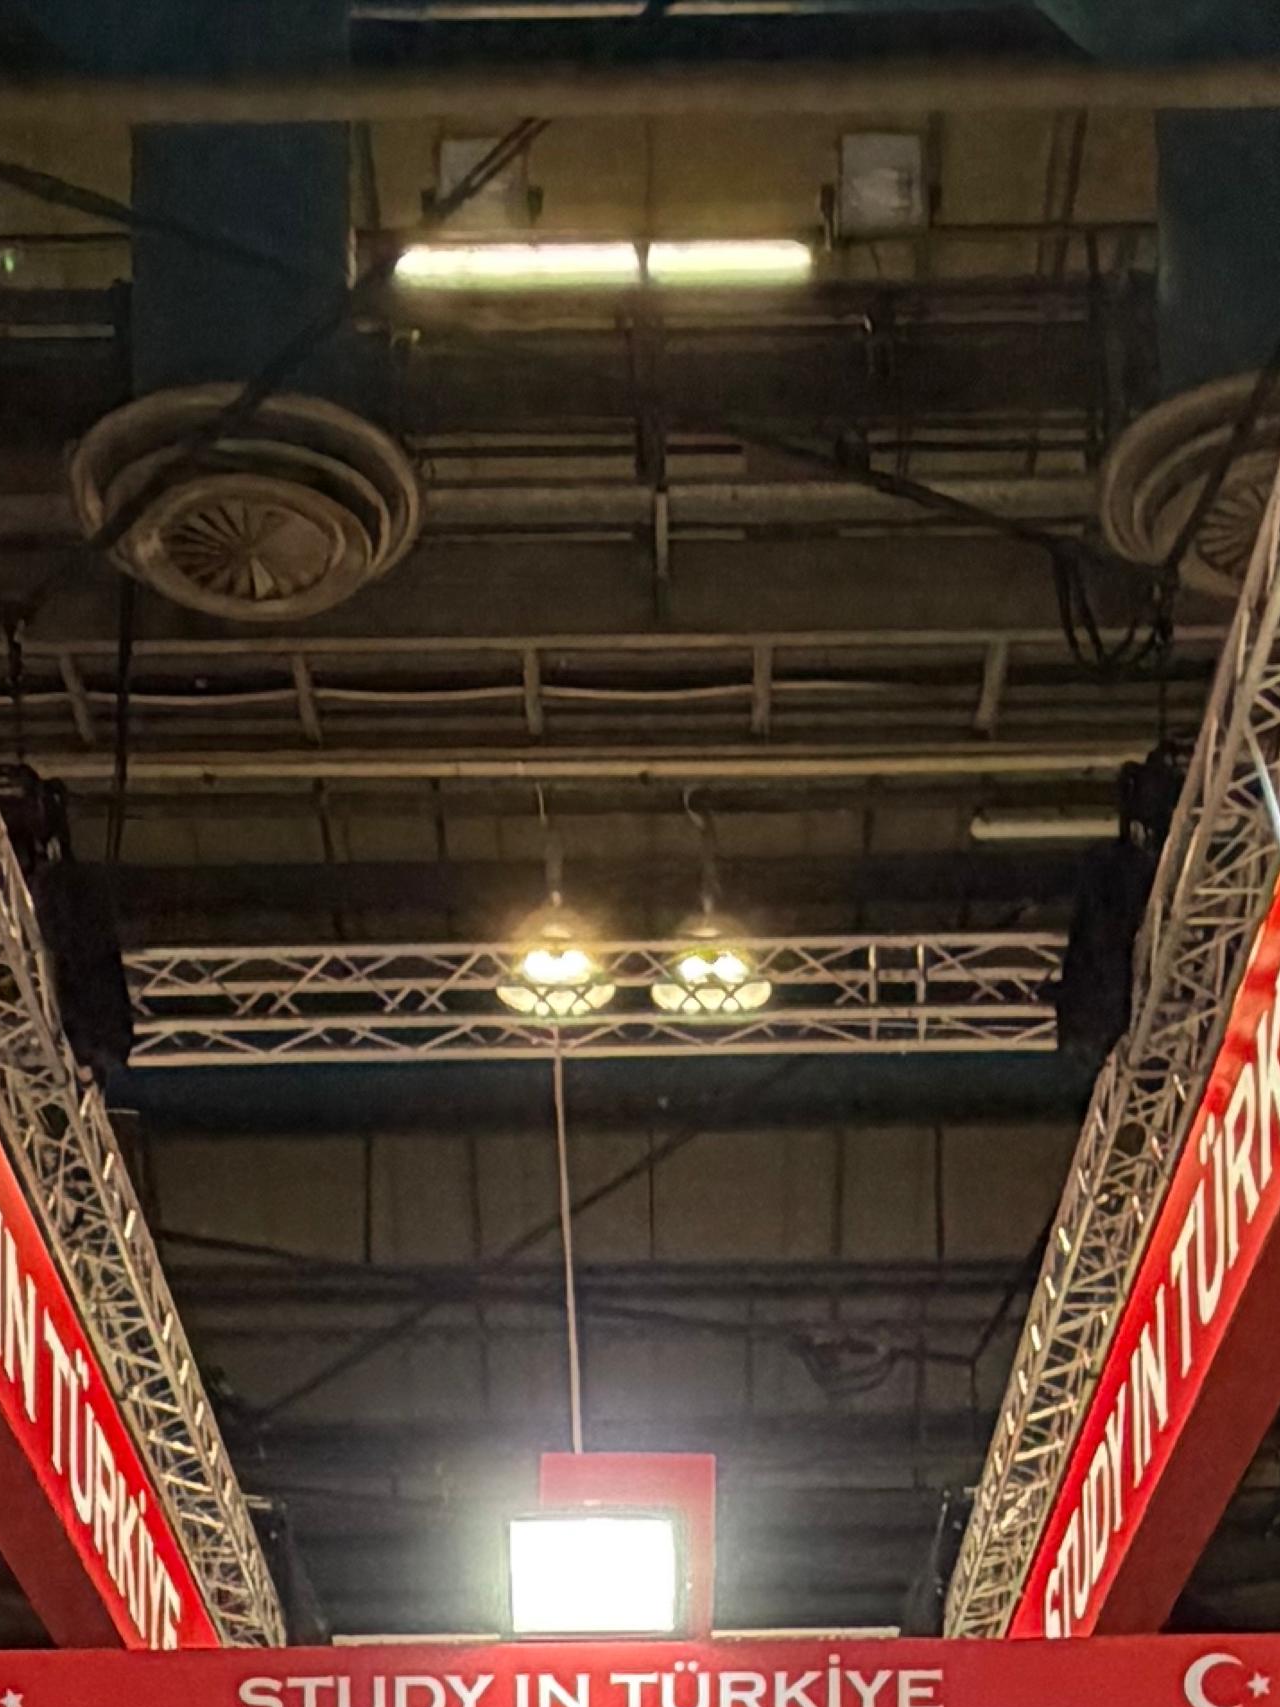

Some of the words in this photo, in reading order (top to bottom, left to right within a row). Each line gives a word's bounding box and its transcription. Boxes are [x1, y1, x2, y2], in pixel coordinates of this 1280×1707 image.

[43, 1324, 181, 1651] TÜRKİYE
[1045, 1381, 1128, 1640] STUDY
[1131, 1283, 1170, 1489] IN
